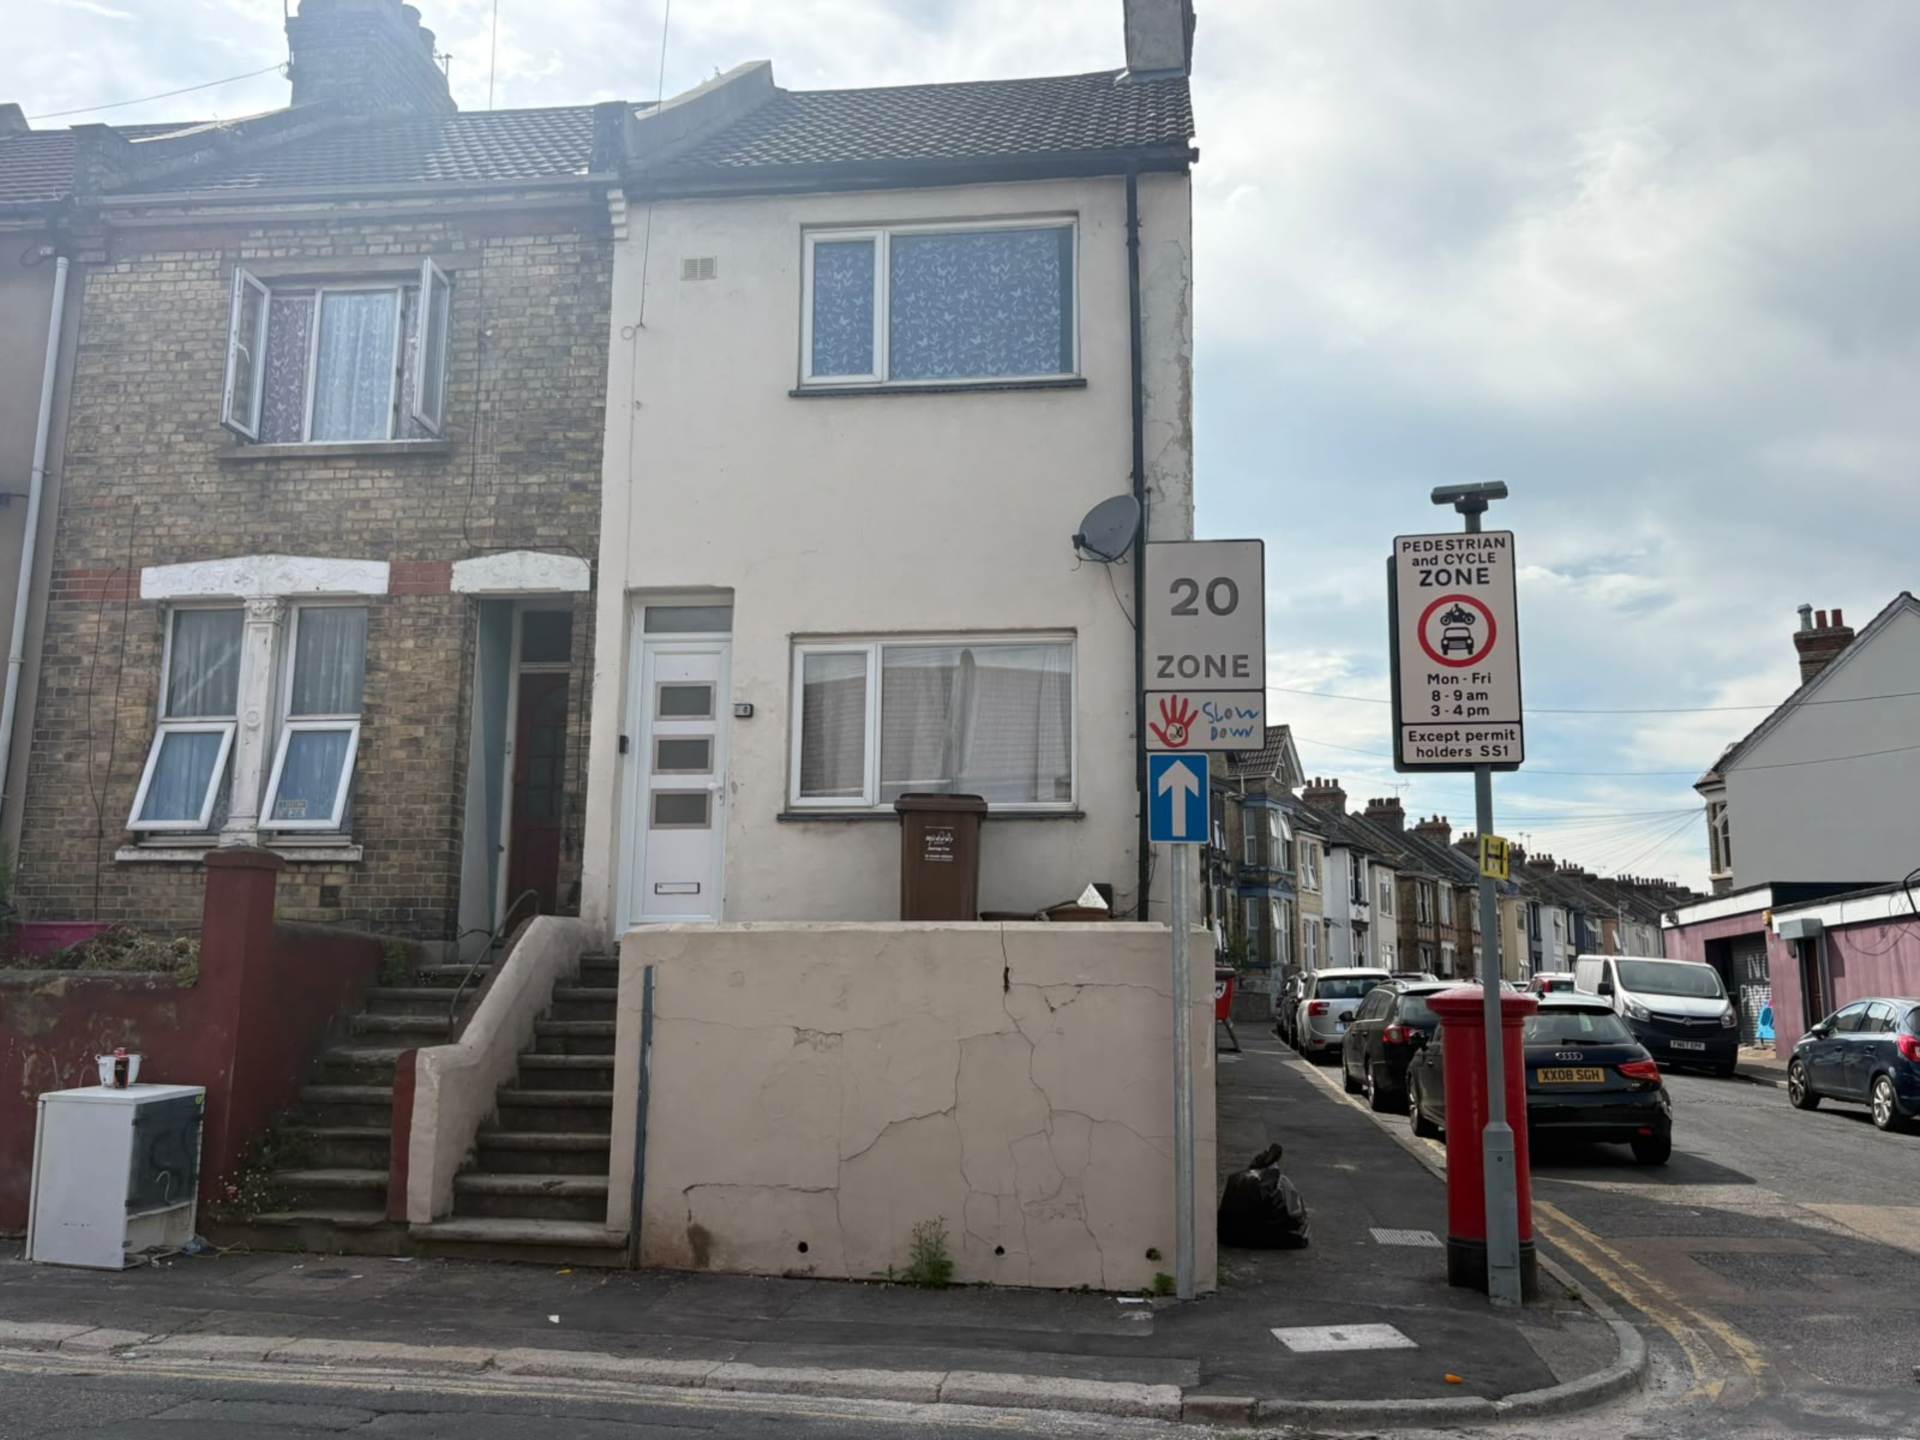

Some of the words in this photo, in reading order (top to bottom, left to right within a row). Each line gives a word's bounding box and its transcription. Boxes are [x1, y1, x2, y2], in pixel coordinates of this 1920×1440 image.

[1402, 537, 1506, 553] PEDESTRIAN
[1412, 555, 1439, 567] and
[1443, 552, 1496, 565] CYCLE
[1418, 567, 1490, 587] ZONE
[1169, 577, 1239, 616] 20
[1156, 654, 1250, 679] ZONE
[1427, 673, 1459, 685] Mon
[1472, 672, 1491, 684] Fri
[1431, 690, 1441, 702] 8
[1453, 690, 1463, 701] 9
[1466, 691, 1488, 701] am
[1431, 705, 1441, 716] 3
[1453, 704, 1463, 716] 4
[1466, 706, 1490, 718] pm
[1408, 730, 1460, 743] Except
[1465, 729, 1516, 743] permit
[1416, 746, 1472, 758] holders
[1480, 745, 1508, 757] SS1
[1484, 838, 1504, 874] H
[1541, 1070, 1573, 1081] XX08
[1577, 1070, 1600, 1080] SGH
